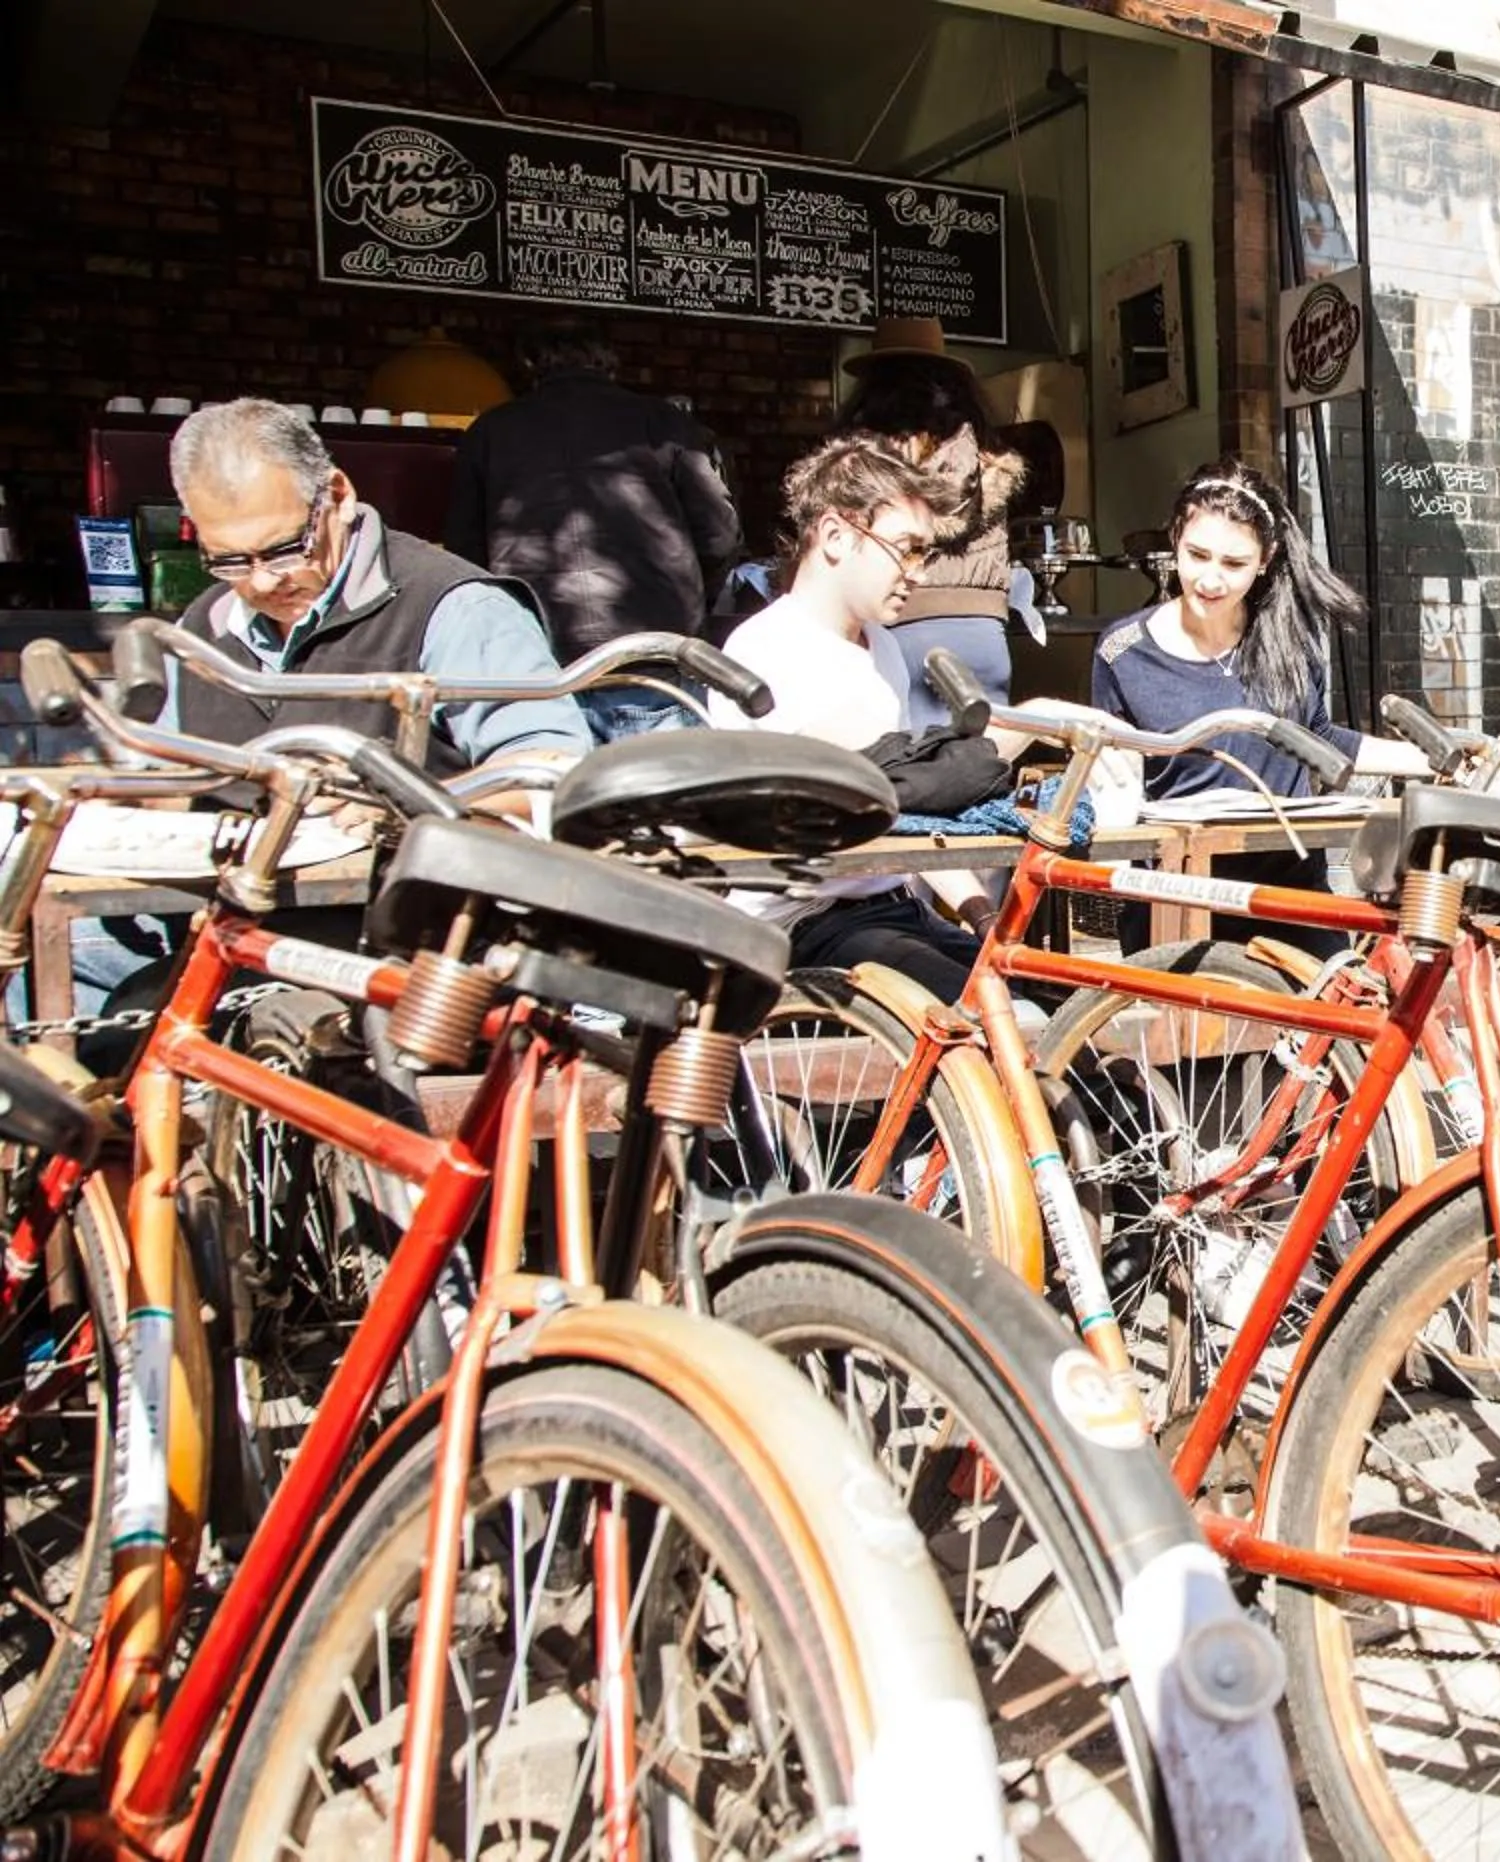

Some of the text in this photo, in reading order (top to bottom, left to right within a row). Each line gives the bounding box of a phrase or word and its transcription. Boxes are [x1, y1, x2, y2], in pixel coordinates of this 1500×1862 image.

[373, 130, 442, 154] ORIGINAL
[346, 152, 474, 185] Uncle
[507, 153, 567, 182] Blanche
[629, 157, 758, 206] MENU
[506, 201, 626, 235] FELIX KING
[764, 197, 868, 222] JACKSON
[886, 187, 999, 248] Coffees
[343, 242, 487, 283] all-natural
[661, 255, 732, 275] JACKY
[891, 246, 960, 268] ESPRESSO
[892, 265, 973, 286] AMERICANO
[893, 282, 975, 302] CAPPUCCINO
